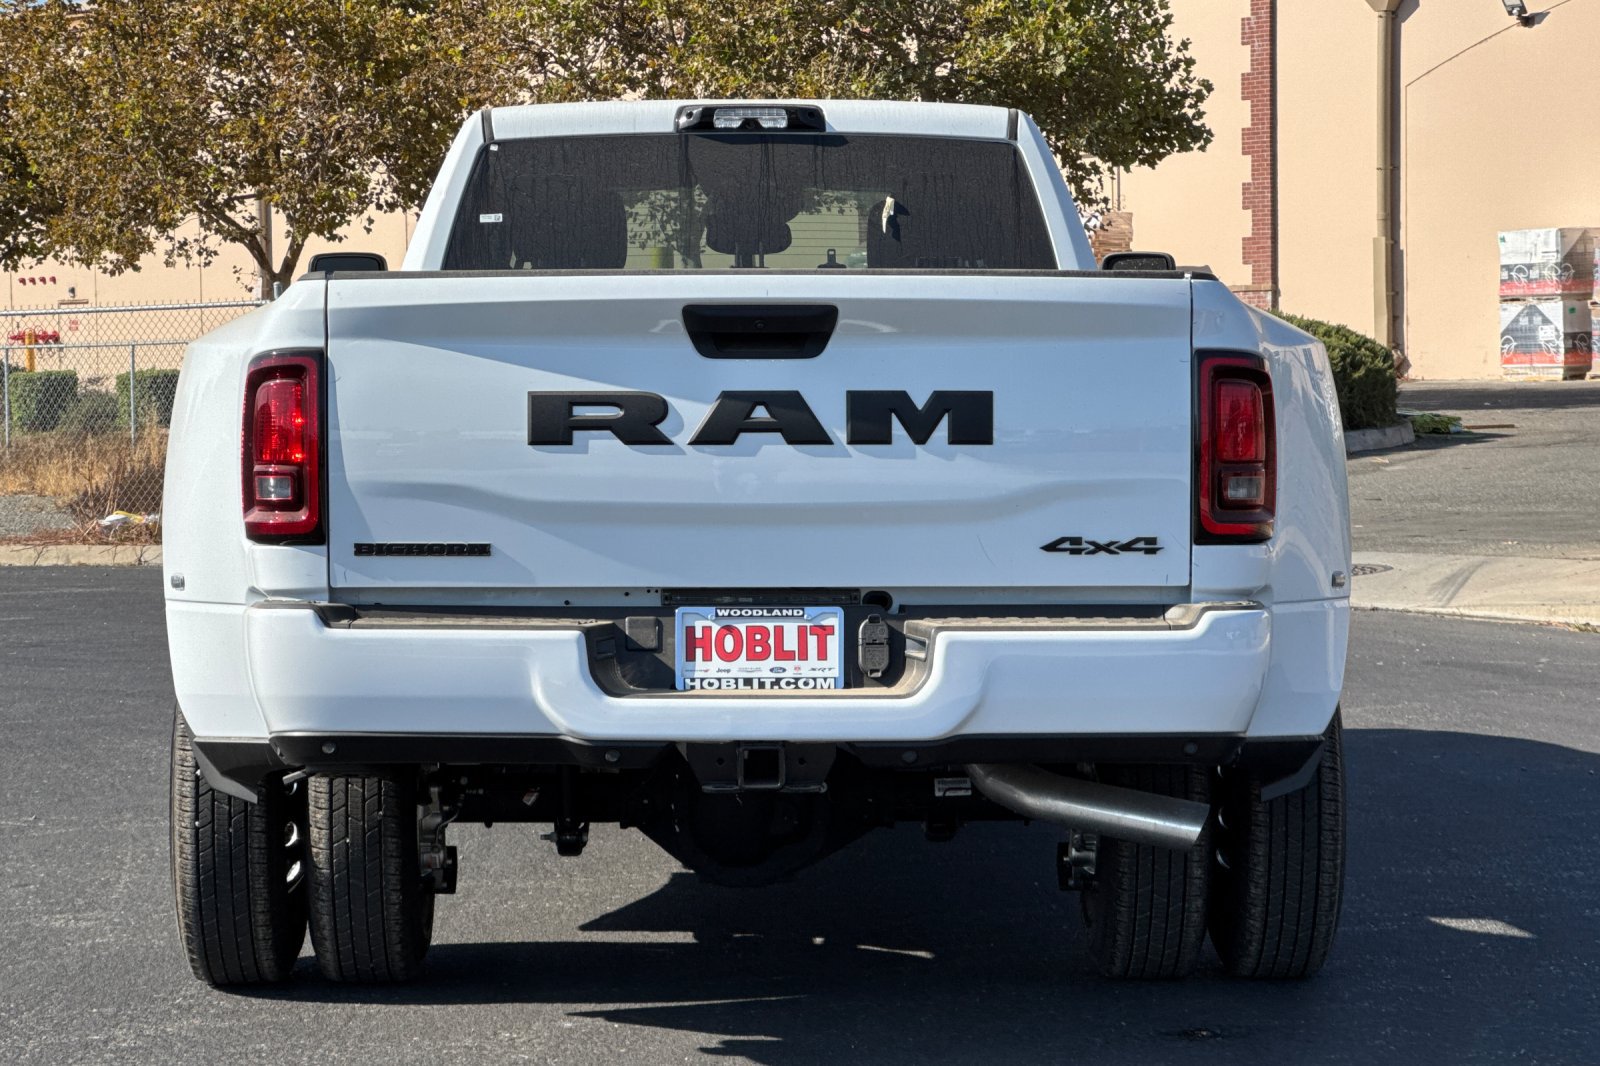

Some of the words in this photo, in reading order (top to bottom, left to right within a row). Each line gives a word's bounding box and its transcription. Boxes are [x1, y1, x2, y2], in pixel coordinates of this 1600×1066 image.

[527, 390, 994, 445] RAM
[1039, 536, 1165, 555] 4x4
[717, 608, 804, 617] WOODLAND
[685, 625, 835, 662] HOBLIT
[684, 678, 835, 689] HOBLIT.COM
